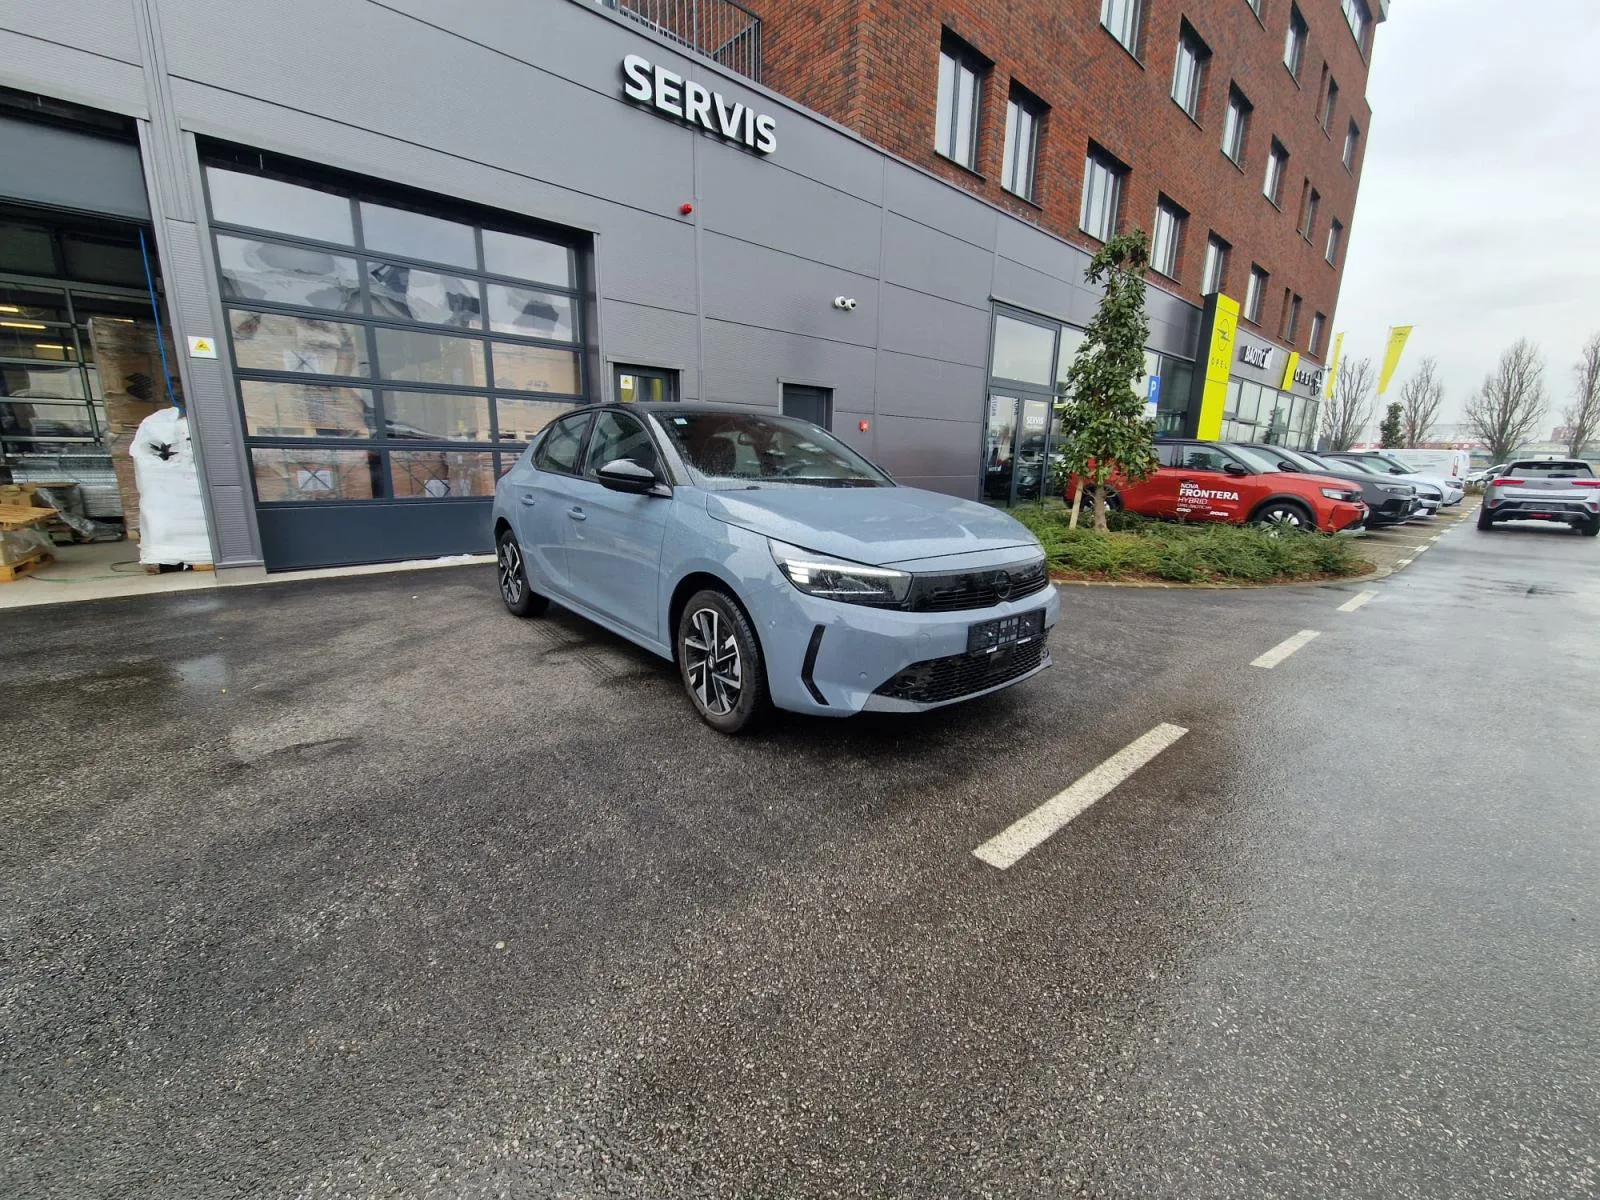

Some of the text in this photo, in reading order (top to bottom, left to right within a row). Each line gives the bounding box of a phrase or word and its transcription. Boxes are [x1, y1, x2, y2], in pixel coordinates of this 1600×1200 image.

[623, 54, 777, 154] SERVIS
[1150, 380, 1157, 397] P
[1177, 496, 1208, 505] HYBRID
[1179, 488, 1239, 501] FRONTERA
